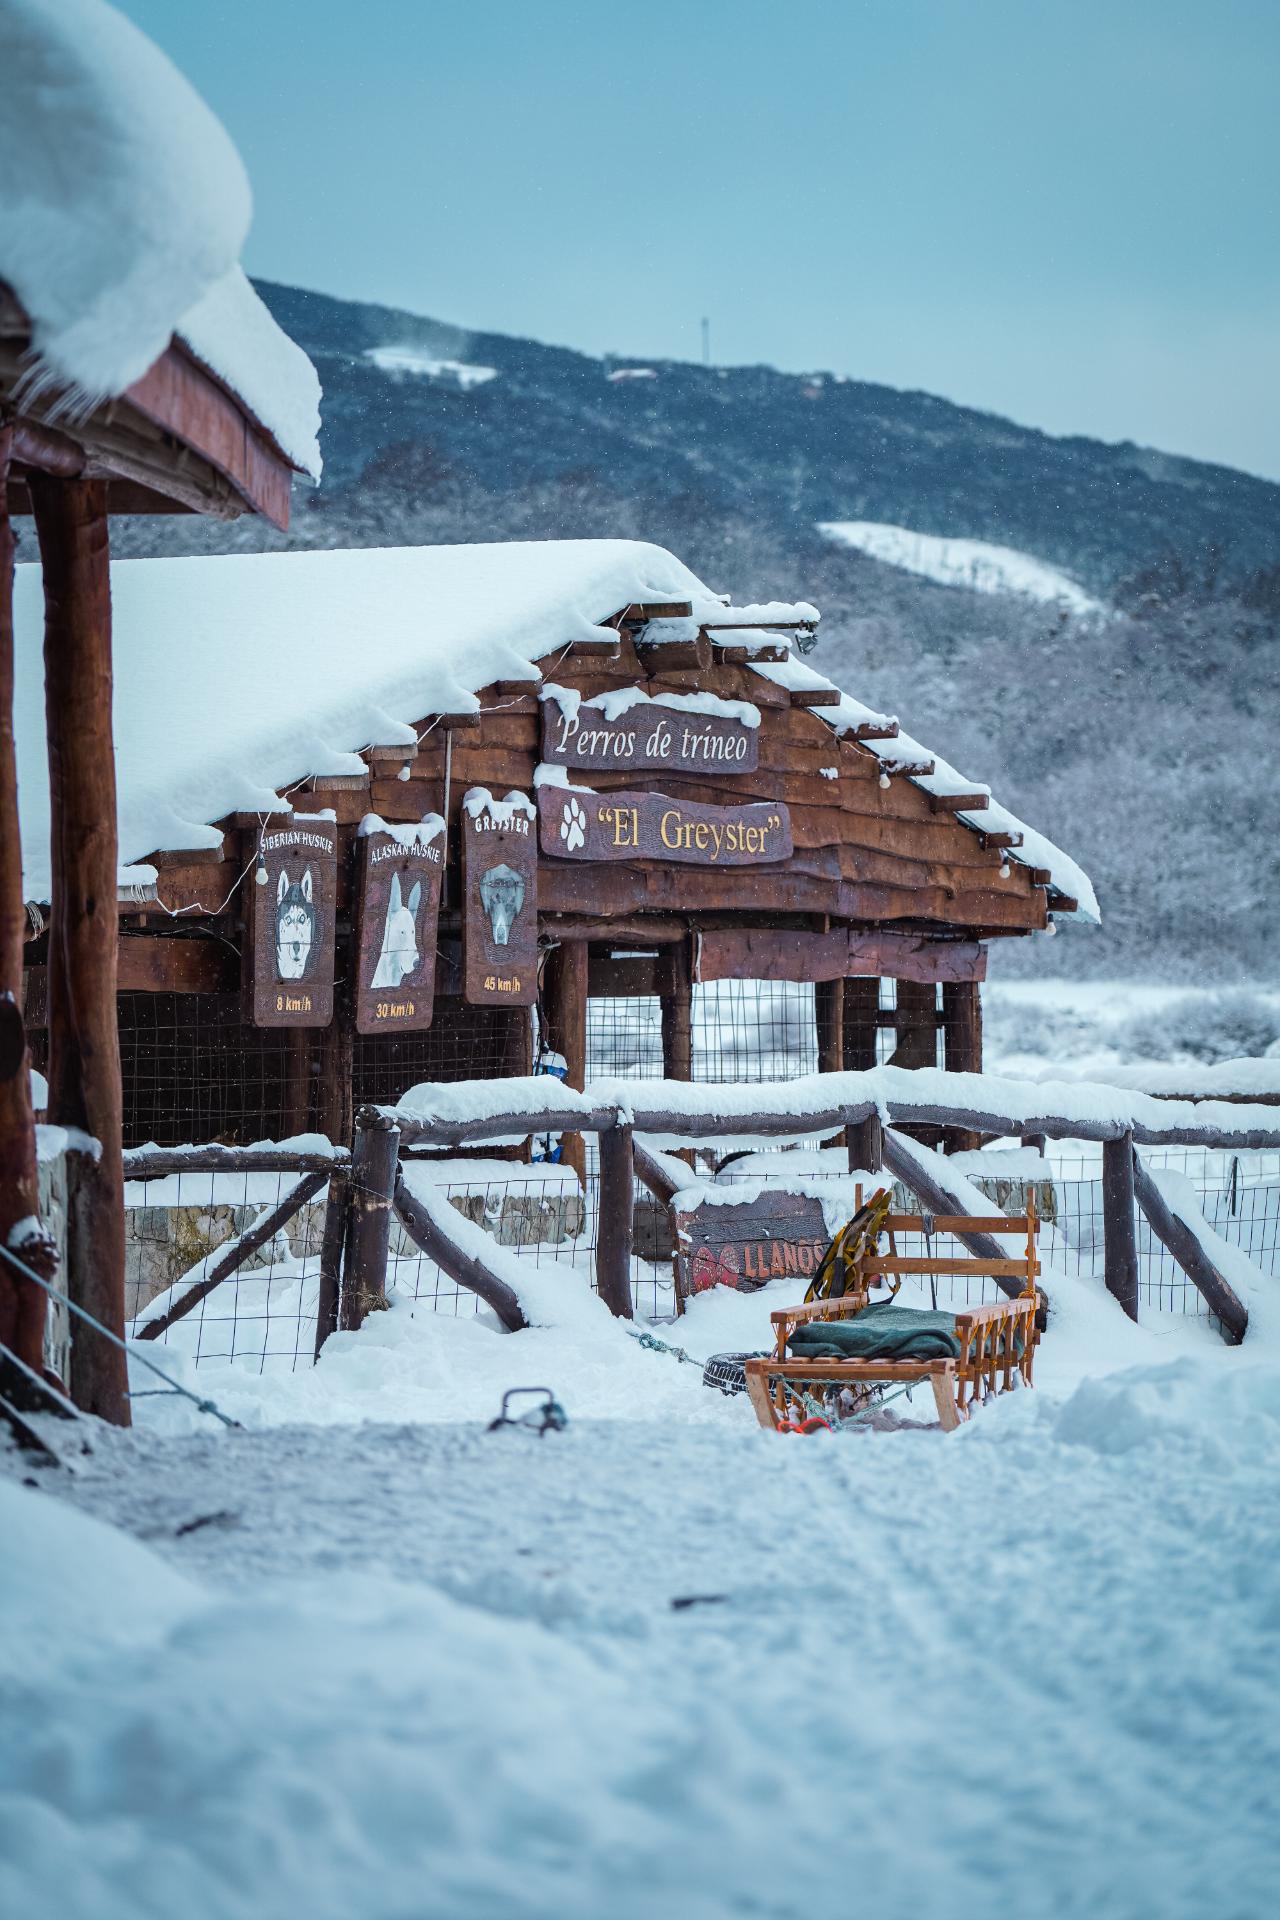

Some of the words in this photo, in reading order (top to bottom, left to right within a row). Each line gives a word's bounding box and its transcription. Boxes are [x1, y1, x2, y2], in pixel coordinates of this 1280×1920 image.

[555, 715, 636, 757] Perros
[645, 721, 672, 758] de
[260, 831, 301, 853] SIBERIAN
[301, 832, 334, 854] HUSKIE
[370, 843, 409, 865] ALASKAN
[410, 843, 441, 863] HUSKIE
[484, 976, 496, 991] 45
[497, 976, 521, 992] km/h
[276, 996, 283, 1011] 8
[285, 996, 312, 1011] km/h
[376, 1003, 388, 1018] 30
[390, 1001, 415, 1018] km/h
